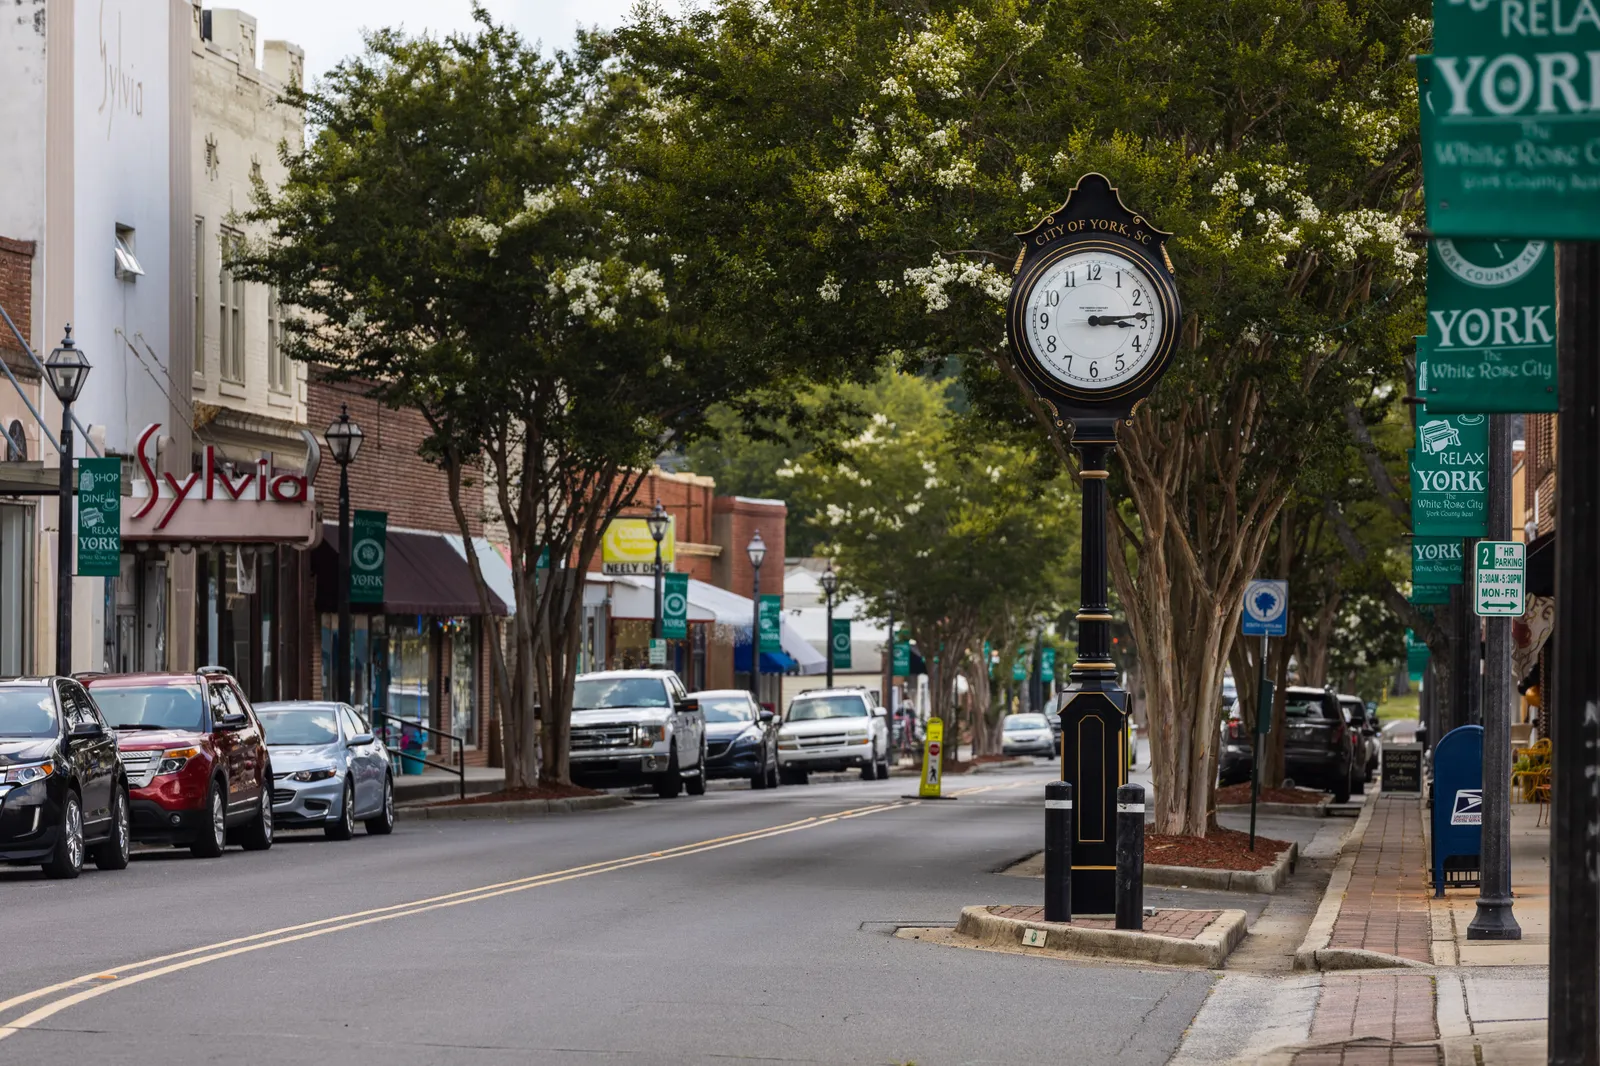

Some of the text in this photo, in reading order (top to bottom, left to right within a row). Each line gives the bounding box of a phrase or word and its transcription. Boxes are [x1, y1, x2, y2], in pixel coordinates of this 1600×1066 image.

[1501, 0, 1600, 37] RELA
[1035, 219, 1152, 246] CITY OF YORK, SC
[1466, 263, 1520, 281] COUNTY
[1523, 240, 1541, 265] SEA
[1064, 271, 1076, 288] 11
[1086, 264, 1103, 281] 12
[1115, 271, 1122, 288] 1
[1045, 290, 1060, 307] 10
[1132, 289, 1142, 306] 2
[1040, 312, 1049, 330] 9
[1139, 312, 1148, 330] 3
[1430, 305, 1554, 347] YORK
[1046, 335, 1057, 353] 8
[1131, 335, 1142, 353] 4
[1062, 355, 1073, 373] 7
[1114, 354, 1125, 371] 5
[1483, 350, 1501, 361] The
[1089, 361, 1099, 378] 6
[1431, 359, 1552, 380] White Rose City
[1439, 452, 1485, 465] RELAX
[94, 472, 119, 483] SHOP
[130, 423, 308, 531] Sylvia
[1416, 470, 1486, 491] YORK
[82, 494, 105, 504] DINE
[1417, 499, 1484, 511] White Rose City
[91, 526, 119, 535] RELAX
[79, 537, 119, 550] YORK
[1414, 543, 1462, 560] YORK
[1482, 547, 1515, 566] 2 HR
[1495, 558, 1523, 567] PARKING
[606, 563, 670, 573] NEELY DRG
[351, 574, 383, 586] YORK
